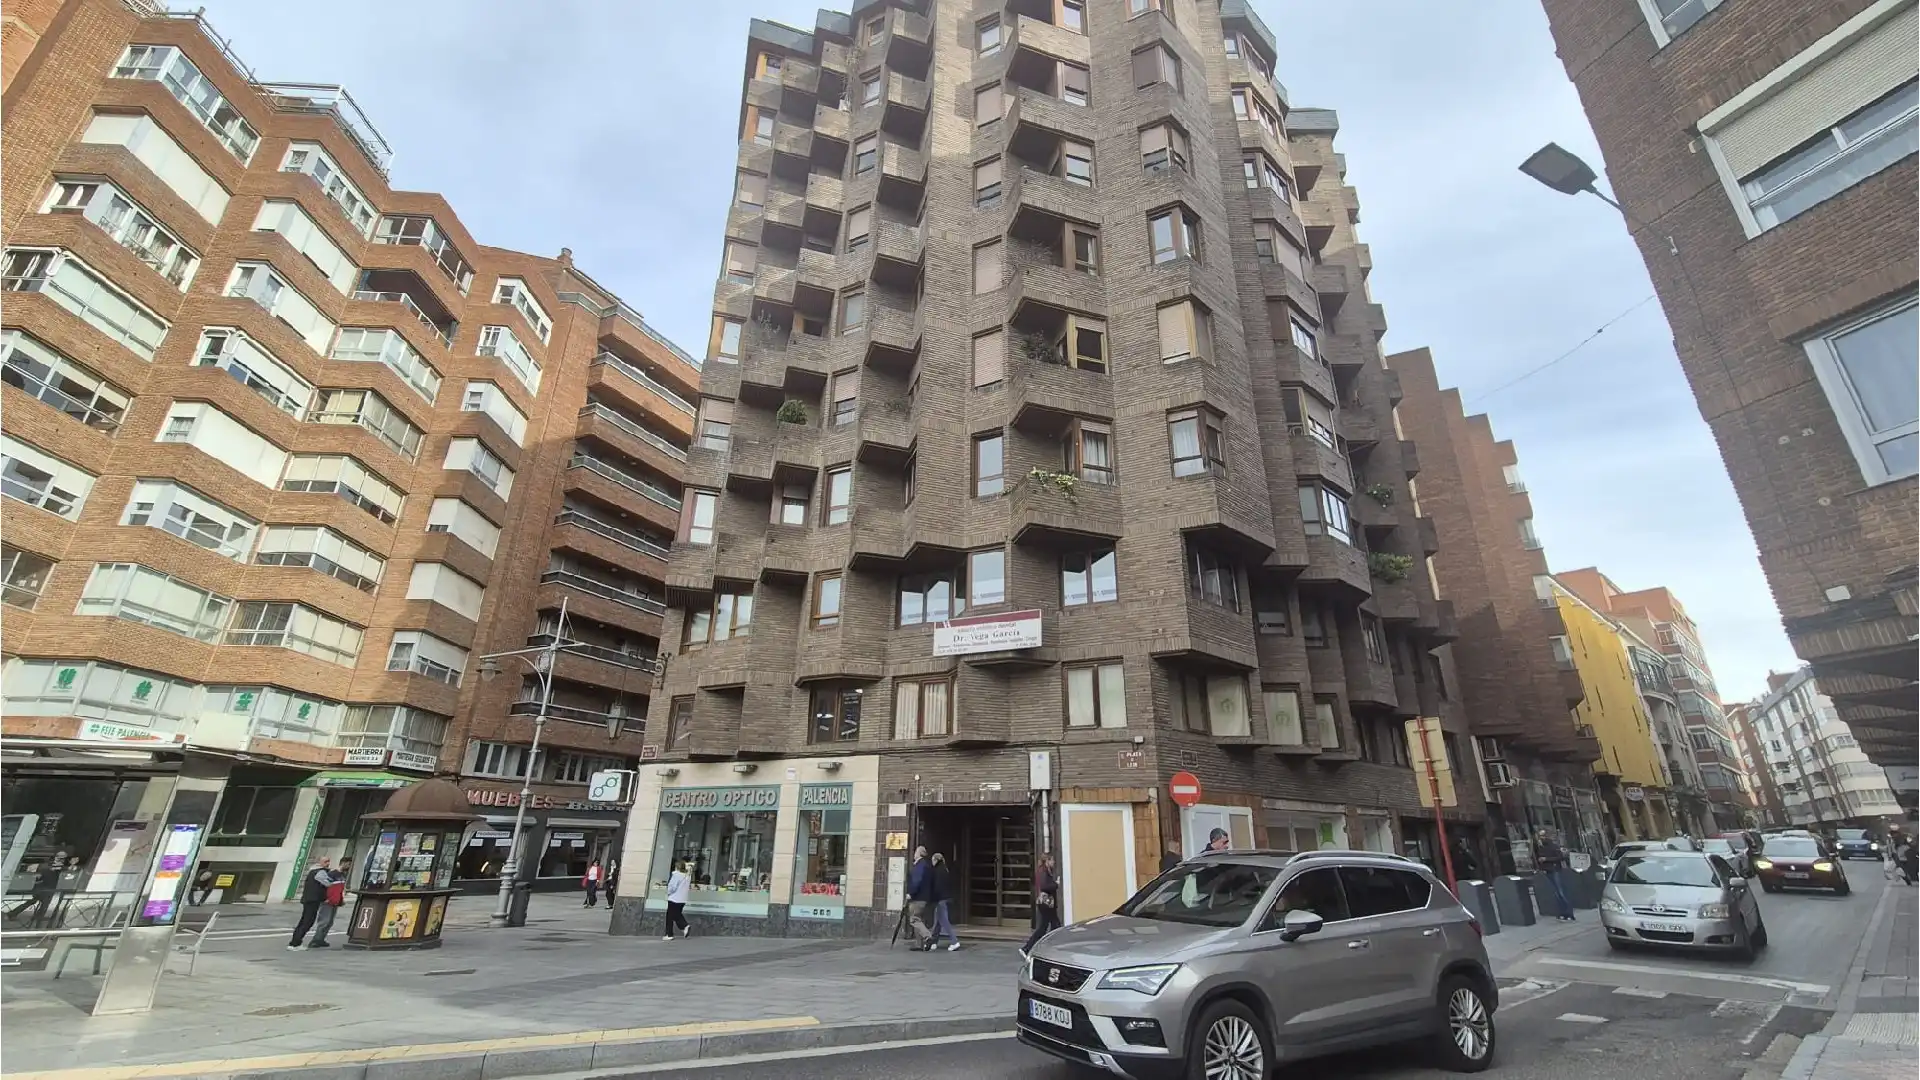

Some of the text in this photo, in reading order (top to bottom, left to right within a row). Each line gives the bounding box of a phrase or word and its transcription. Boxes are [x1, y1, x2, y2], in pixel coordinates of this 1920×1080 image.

[953, 634, 967, 643] Dr.
[971, 631, 989, 640] Vega
[467, 789, 554, 809] MUEBES
[664, 787, 849, 808] CENTRO OPTICO PALENCIA
[1034, 1002, 1053, 1020] 8788
